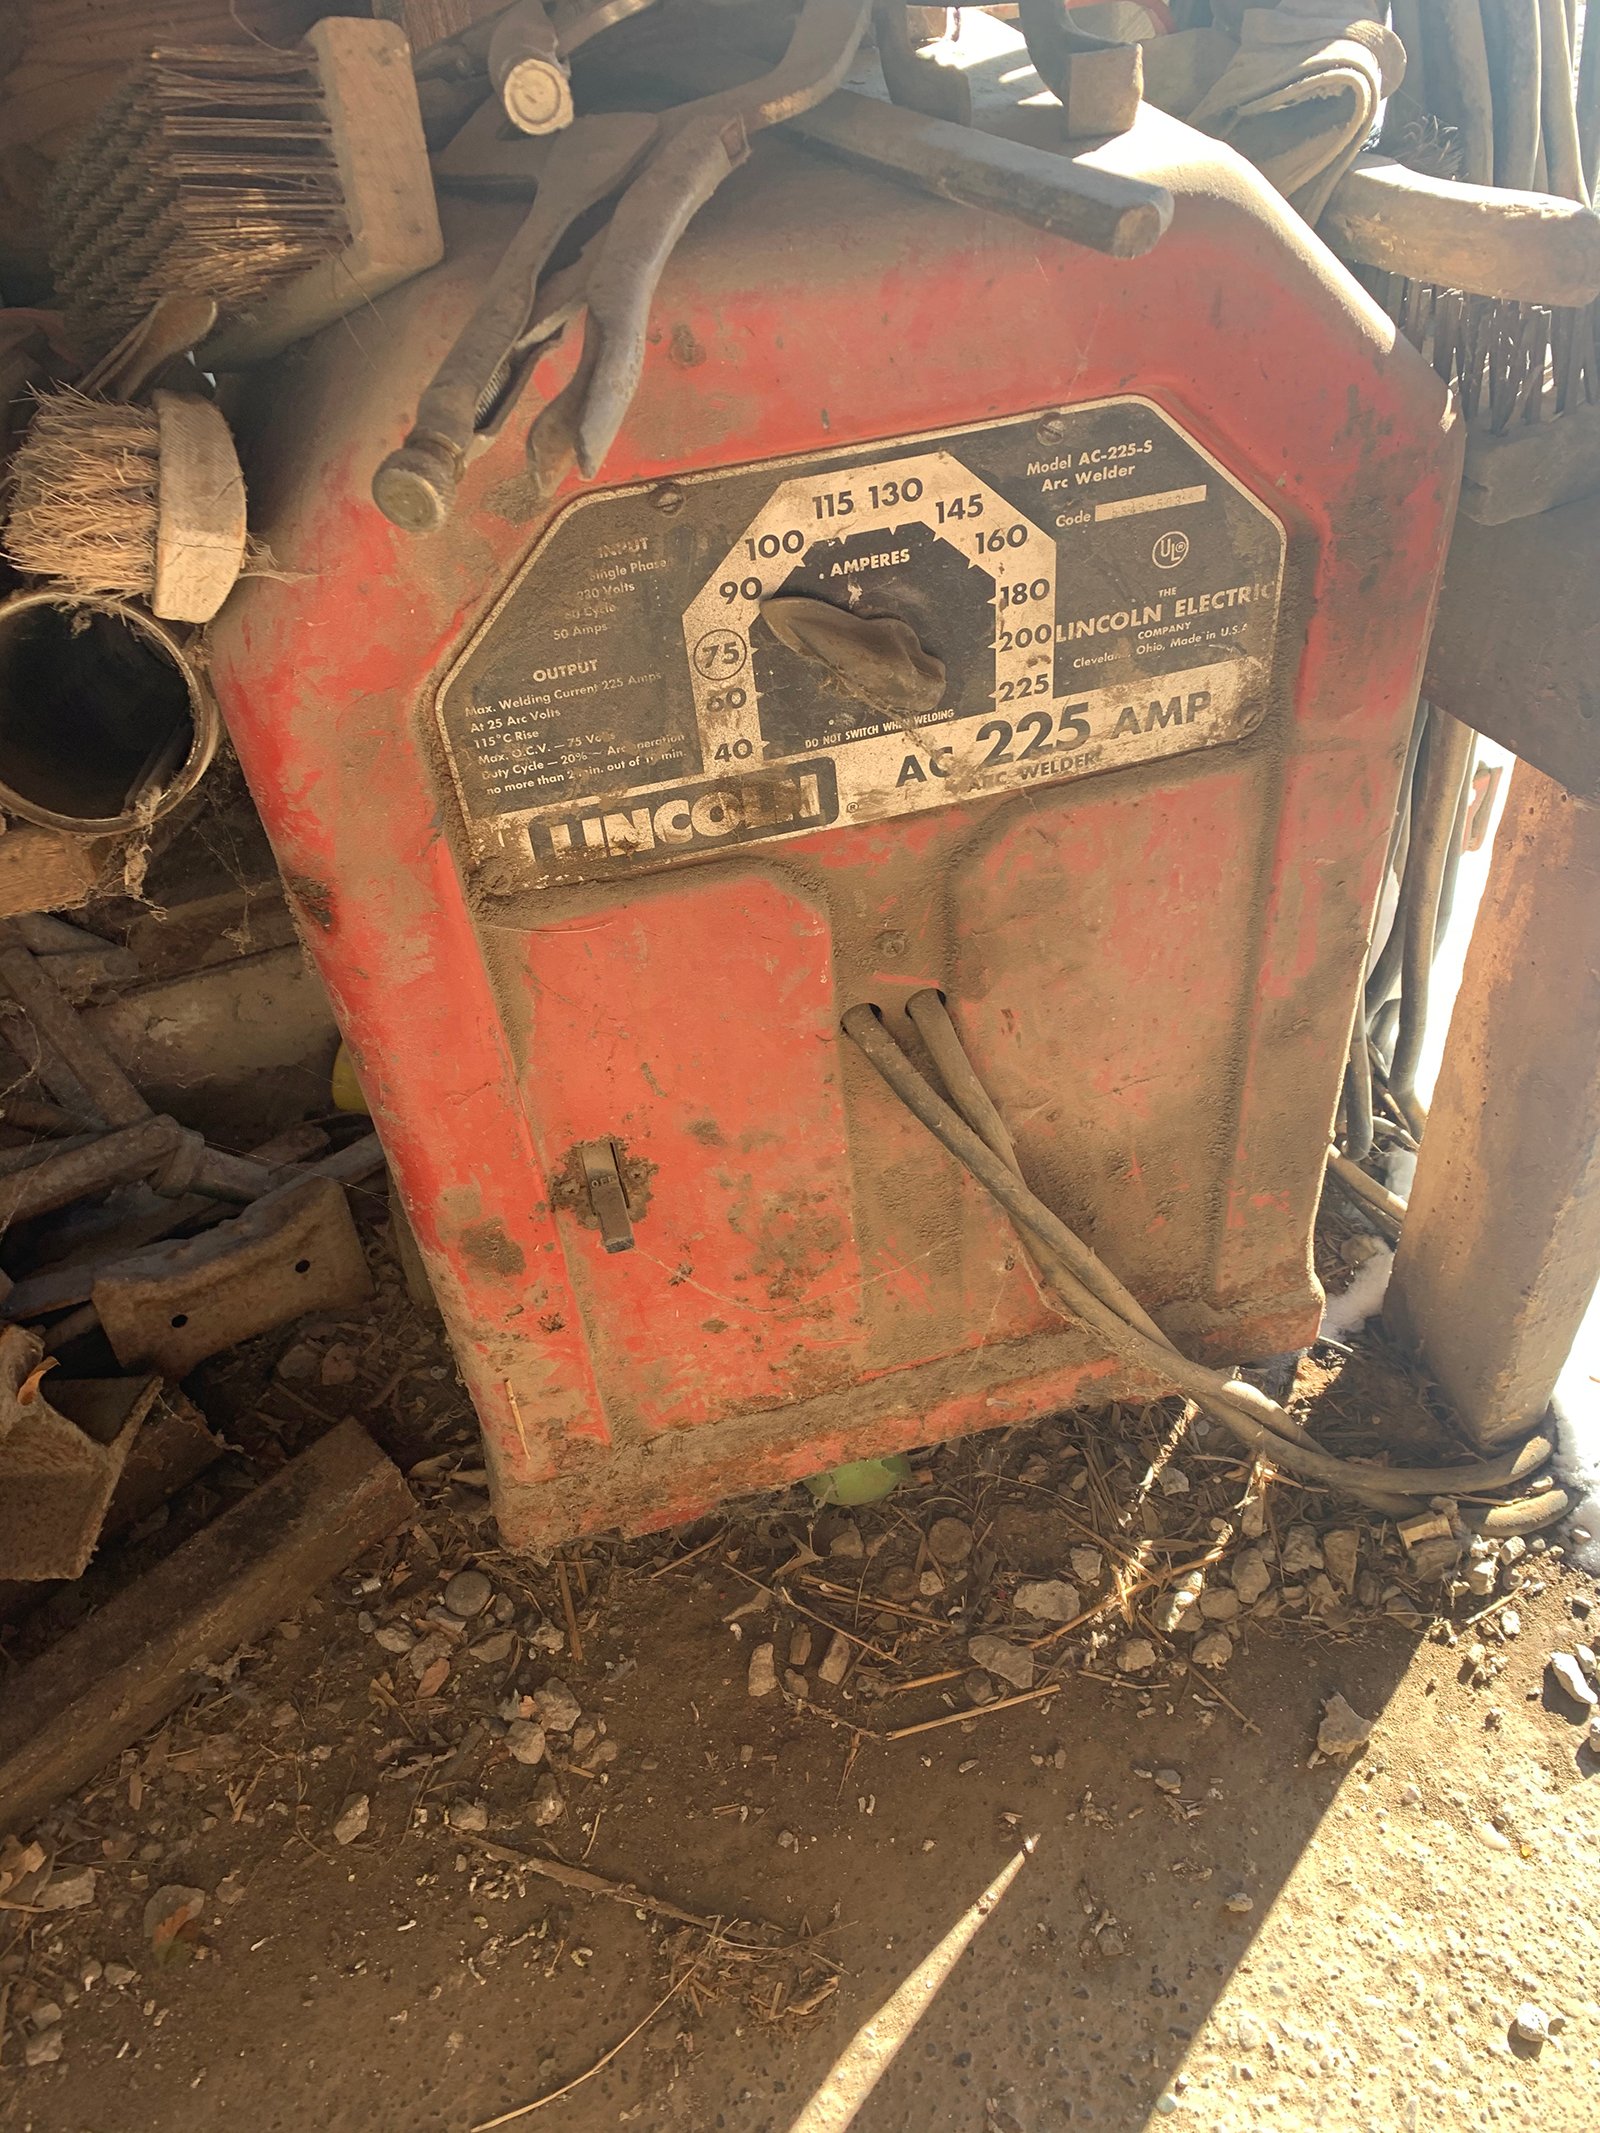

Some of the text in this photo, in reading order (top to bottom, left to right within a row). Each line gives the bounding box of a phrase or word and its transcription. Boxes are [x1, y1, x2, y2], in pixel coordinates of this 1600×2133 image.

[1026, 440, 1153, 476] Model AC-225-S
[1041, 465, 1136, 493] Arc Welder
[812, 490, 854, 519] 115
[868, 478, 924, 509] 130
[935, 493, 984, 524] 145
[1055, 509, 1092, 528] Code
[745, 530, 805, 561] 100
[975, 524, 1028, 554] 160
[630, 560, 667, 573] Phase
[830, 549, 911, 577] AMPERES
[602, 582, 636, 596] Volts
[719, 576, 763, 605] 90
[1000, 578, 1050, 608] 180
[1158, 586, 1177, 598] THE
[1055, 581, 1275, 643] LINCOLN ELECTRIC
[553, 623, 608, 641] 50 Amps
[999, 623, 1052, 653] 200
[1136, 641, 1166, 656] Ohio,
[1170, 633, 1202, 648] Made
[1205, 630, 1216, 640] in
[1137, 621, 1191, 640] COMPANY
[701, 641, 740, 669] 75
[532, 659, 598, 682] OUTPUT
[465, 671, 662, 718] Max. Welding Current 225 Amps
[998, 674, 1049, 702] 225
[470, 708, 561, 734] At 25 Arc Volts
[804, 738, 819, 750] DO
[822, 732, 842, 745] NOT
[845, 724, 880, 741] SWITCH
[913, 708, 955, 726] WELDING
[514, 730, 540, 742] Rise
[895, 691, 1212, 788] AC 225 AMP
[479, 752, 510, 765] Max.
[511, 743, 551, 760] O.C.V.
[567, 737, 583, 748] 75
[512, 762, 545, 776] Cycle
[560, 751, 588, 765] 20%
[714, 738, 753, 764] 40
[486, 786, 502, 795] no
[504, 779, 535, 793] more
[537, 772, 565, 786] than
[566, 769, 574, 780] 2
[606, 760, 626, 772] out
[628, 755, 640, 767] of
[1020, 752, 1097, 780] WELDER
